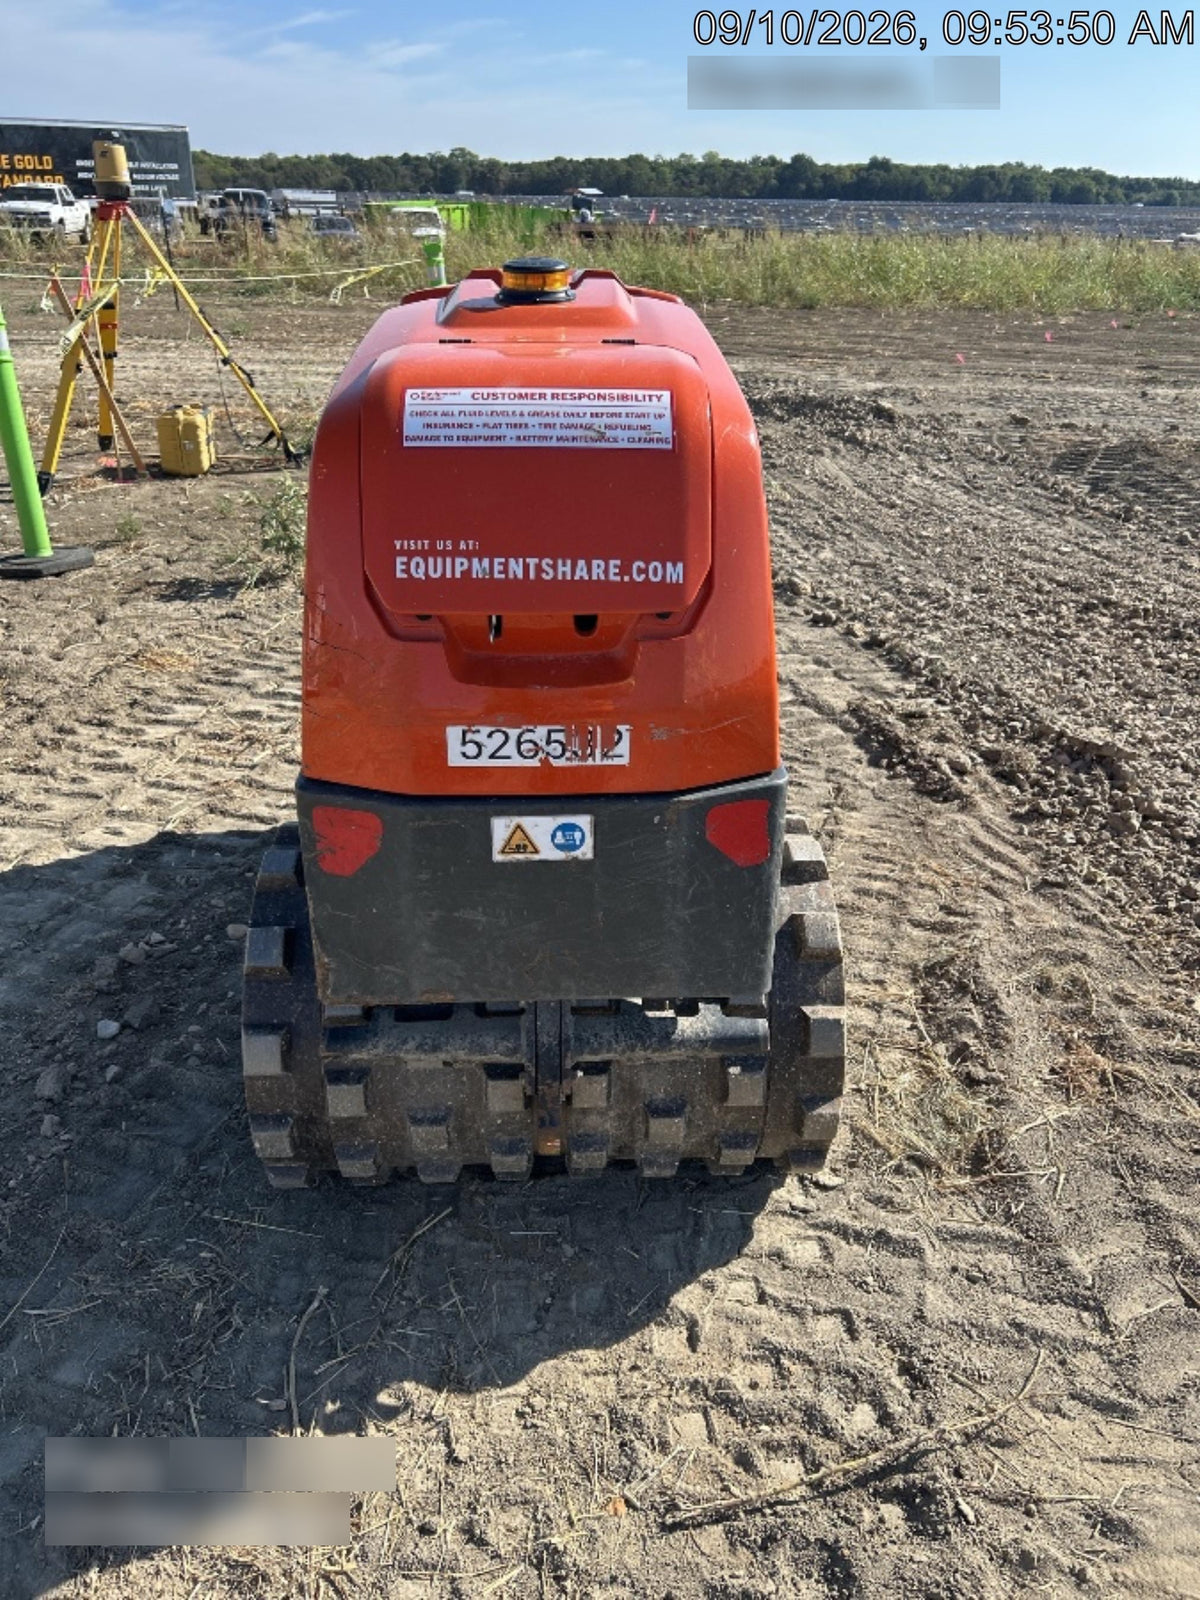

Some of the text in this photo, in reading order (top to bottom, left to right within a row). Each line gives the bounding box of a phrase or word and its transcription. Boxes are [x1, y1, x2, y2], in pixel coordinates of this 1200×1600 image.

[13, 154, 54, 170] GOLD
[470, 391, 548, 401] CUSTOMER
[550, 391, 664, 403] RESPONSIBILITY
[527, 410, 560, 418] GREASE
[563, 411, 587, 419] DAILY
[589, 411, 622, 419] BEFORE
[422, 422, 474, 430] INSURANCE
[505, 422, 529, 430] TIRES
[538, 422, 557, 430] TIRE
[404, 434, 671, 445] DAMAGE TO EQUIPMENT BATTERY MAINTENANCE CLEANING
[394, 540, 480, 550] VISIT US AT:
[395, 556, 684, 584] EQUIPMENTSHARE.COM
